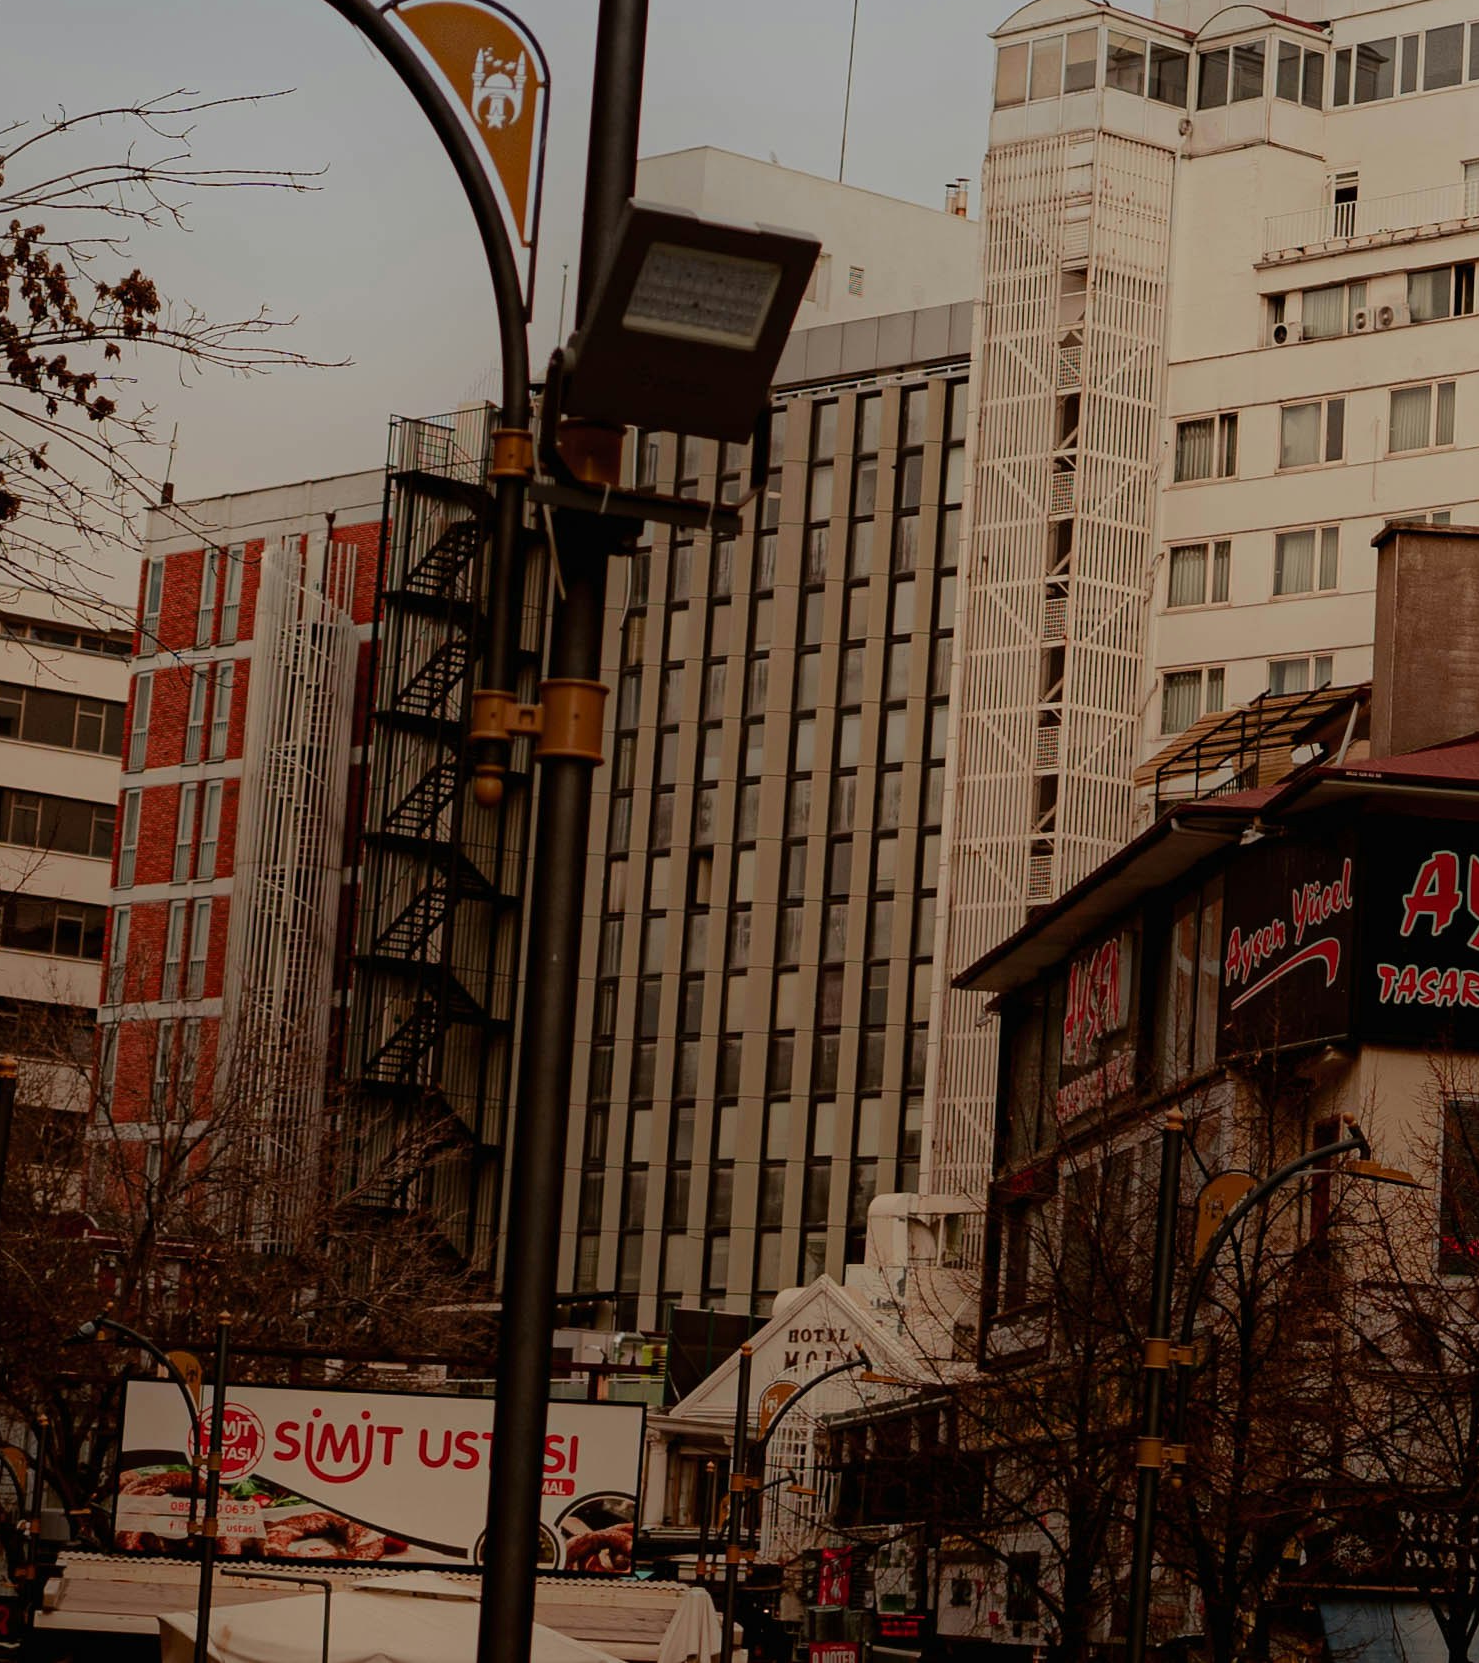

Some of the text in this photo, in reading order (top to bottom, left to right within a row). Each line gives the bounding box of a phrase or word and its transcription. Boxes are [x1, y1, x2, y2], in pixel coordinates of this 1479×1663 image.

[1224, 856, 1353, 986] Ayşen Yücel
[786, 1327, 850, 1344] HOTEL
[418, 1429, 579, 1475] USSI
